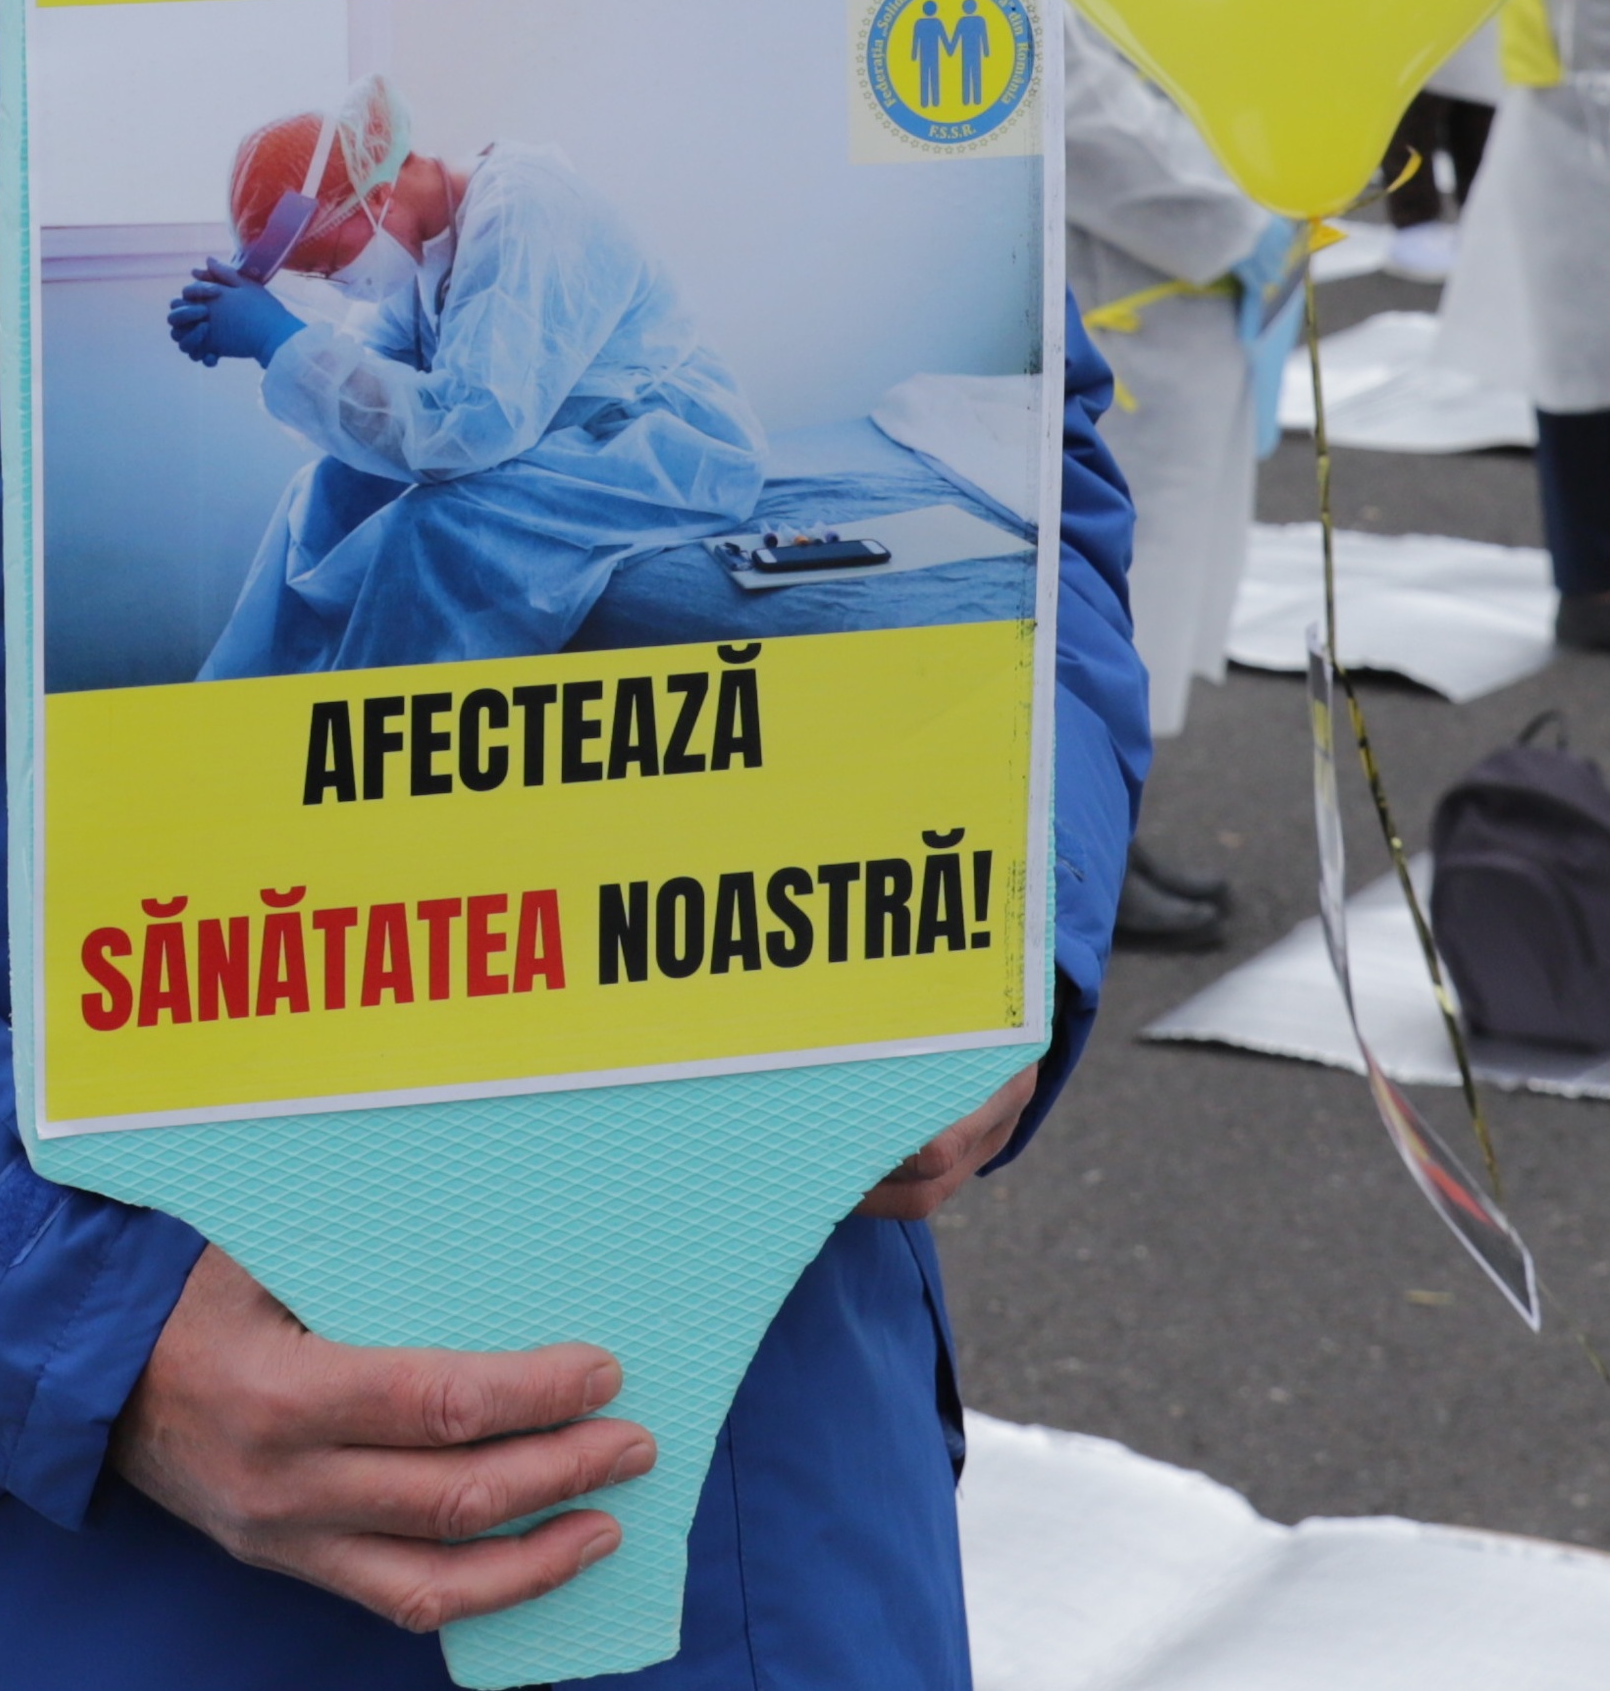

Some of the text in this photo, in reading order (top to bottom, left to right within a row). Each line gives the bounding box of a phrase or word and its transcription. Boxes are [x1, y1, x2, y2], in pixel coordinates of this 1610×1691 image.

[871, 39, 897, 109] Federația
[1007, 12, 1025, 36] din
[927, 123, 977, 140] F.S.S.R.
[302, 642, 763, 806] AFECTEAZĂ
[79, 827, 993, 1032] SĂNĂTATEA NOASTRĂ!
